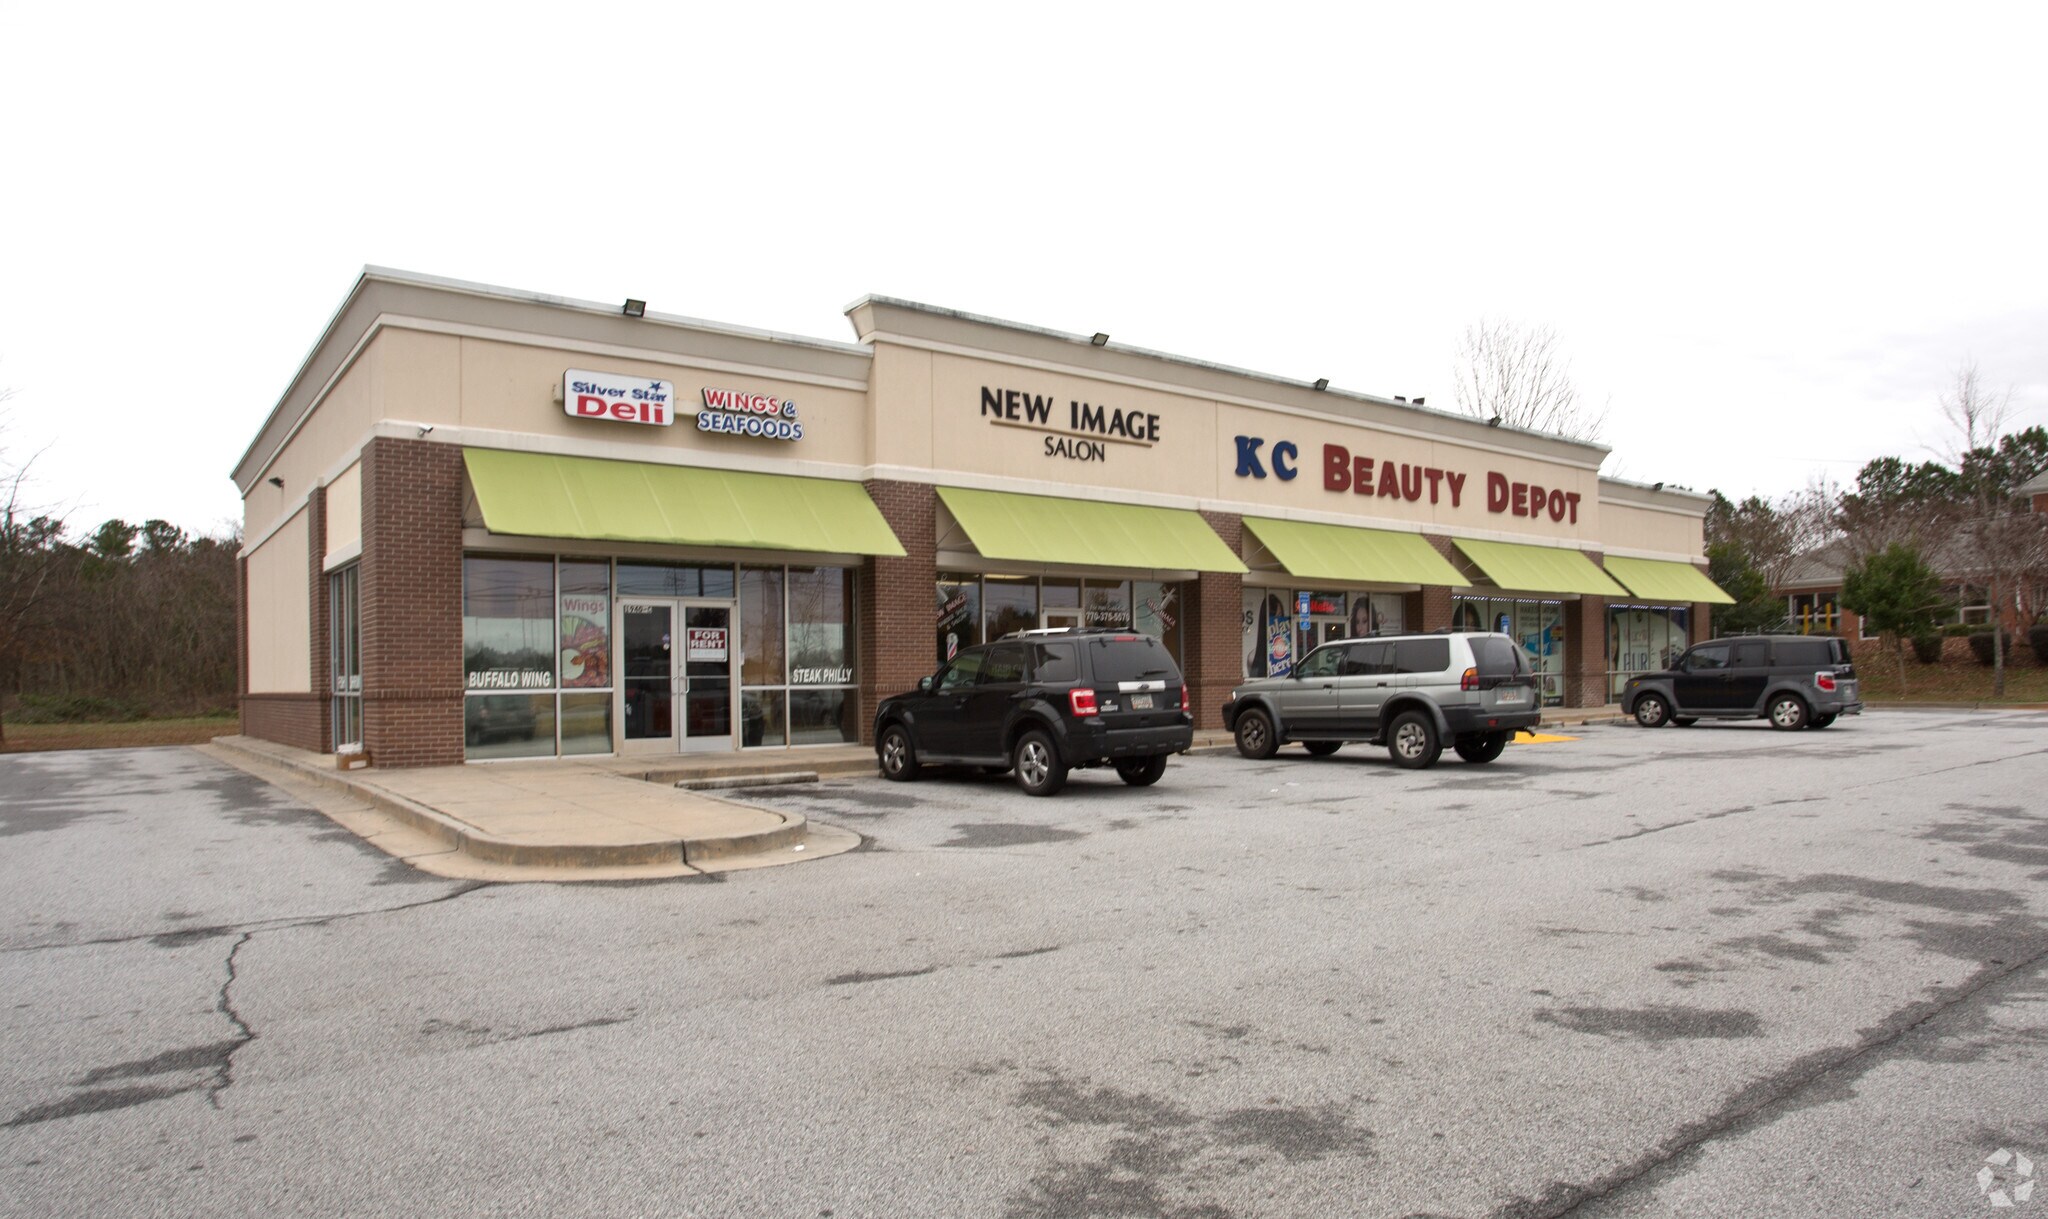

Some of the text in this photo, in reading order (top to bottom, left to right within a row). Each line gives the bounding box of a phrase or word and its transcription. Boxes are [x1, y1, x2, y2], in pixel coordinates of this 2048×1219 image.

[572, 381, 667, 402] Silver Star
[703, 387, 798, 418] WINGS &
[577, 395, 664, 423] Deli
[981, 386, 1160, 442] NEW IMAGE
[698, 412, 804, 440] SEAFOODS
[1044, 436, 1105, 462] SALON
[1323, 443, 1466, 507] BEAUTY
[1488, 471, 1581, 524] DEPOT
[564, 598, 605, 614] Wings
[690, 640, 724, 649] RENT
[694, 631, 720, 640] FOR
[468, 671, 551, 688] BUFFALO WING
[793, 667, 853, 683] STEAK PHILLY
